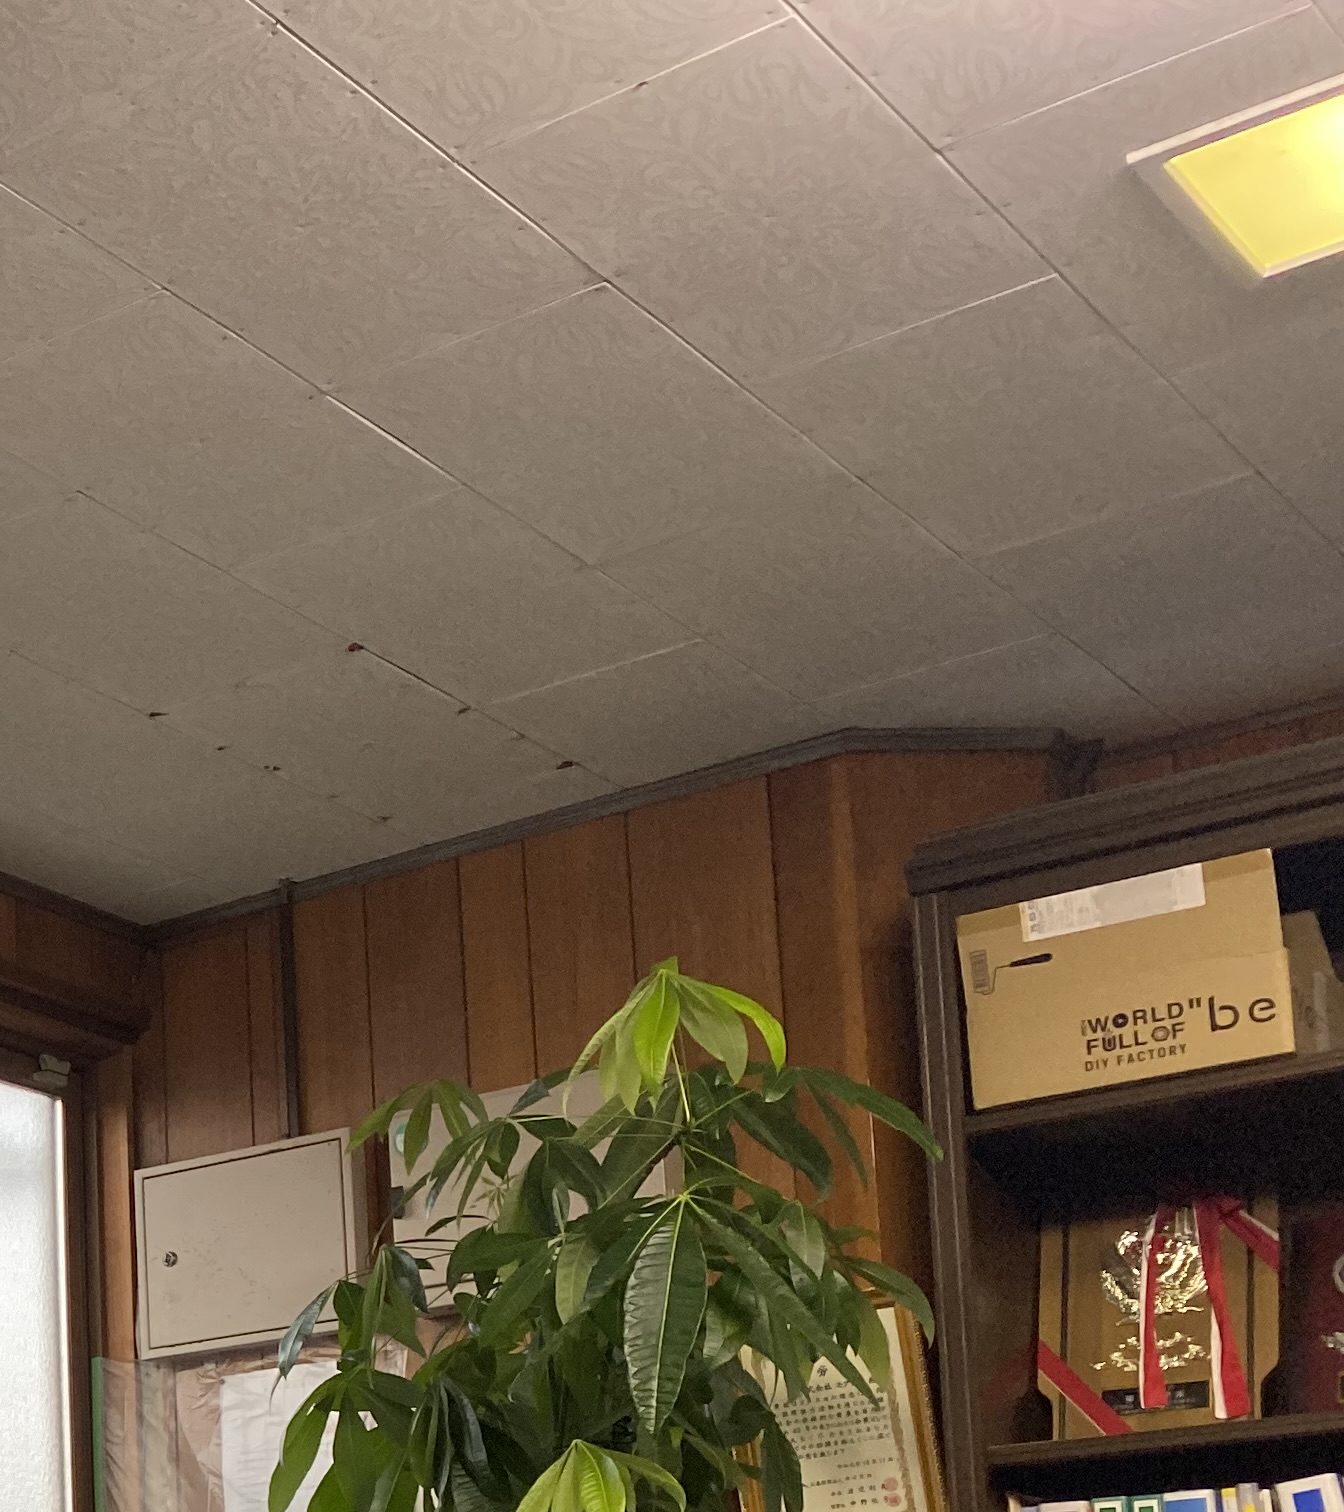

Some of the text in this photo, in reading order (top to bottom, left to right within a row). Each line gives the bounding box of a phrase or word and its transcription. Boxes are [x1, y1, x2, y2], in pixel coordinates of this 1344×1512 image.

[1087, 1002, 1184, 1034] WORLD
[1086, 1021, 1186, 1056] FULL OF
[1085, 1044, 1187, 1072] DIY FACTORY
